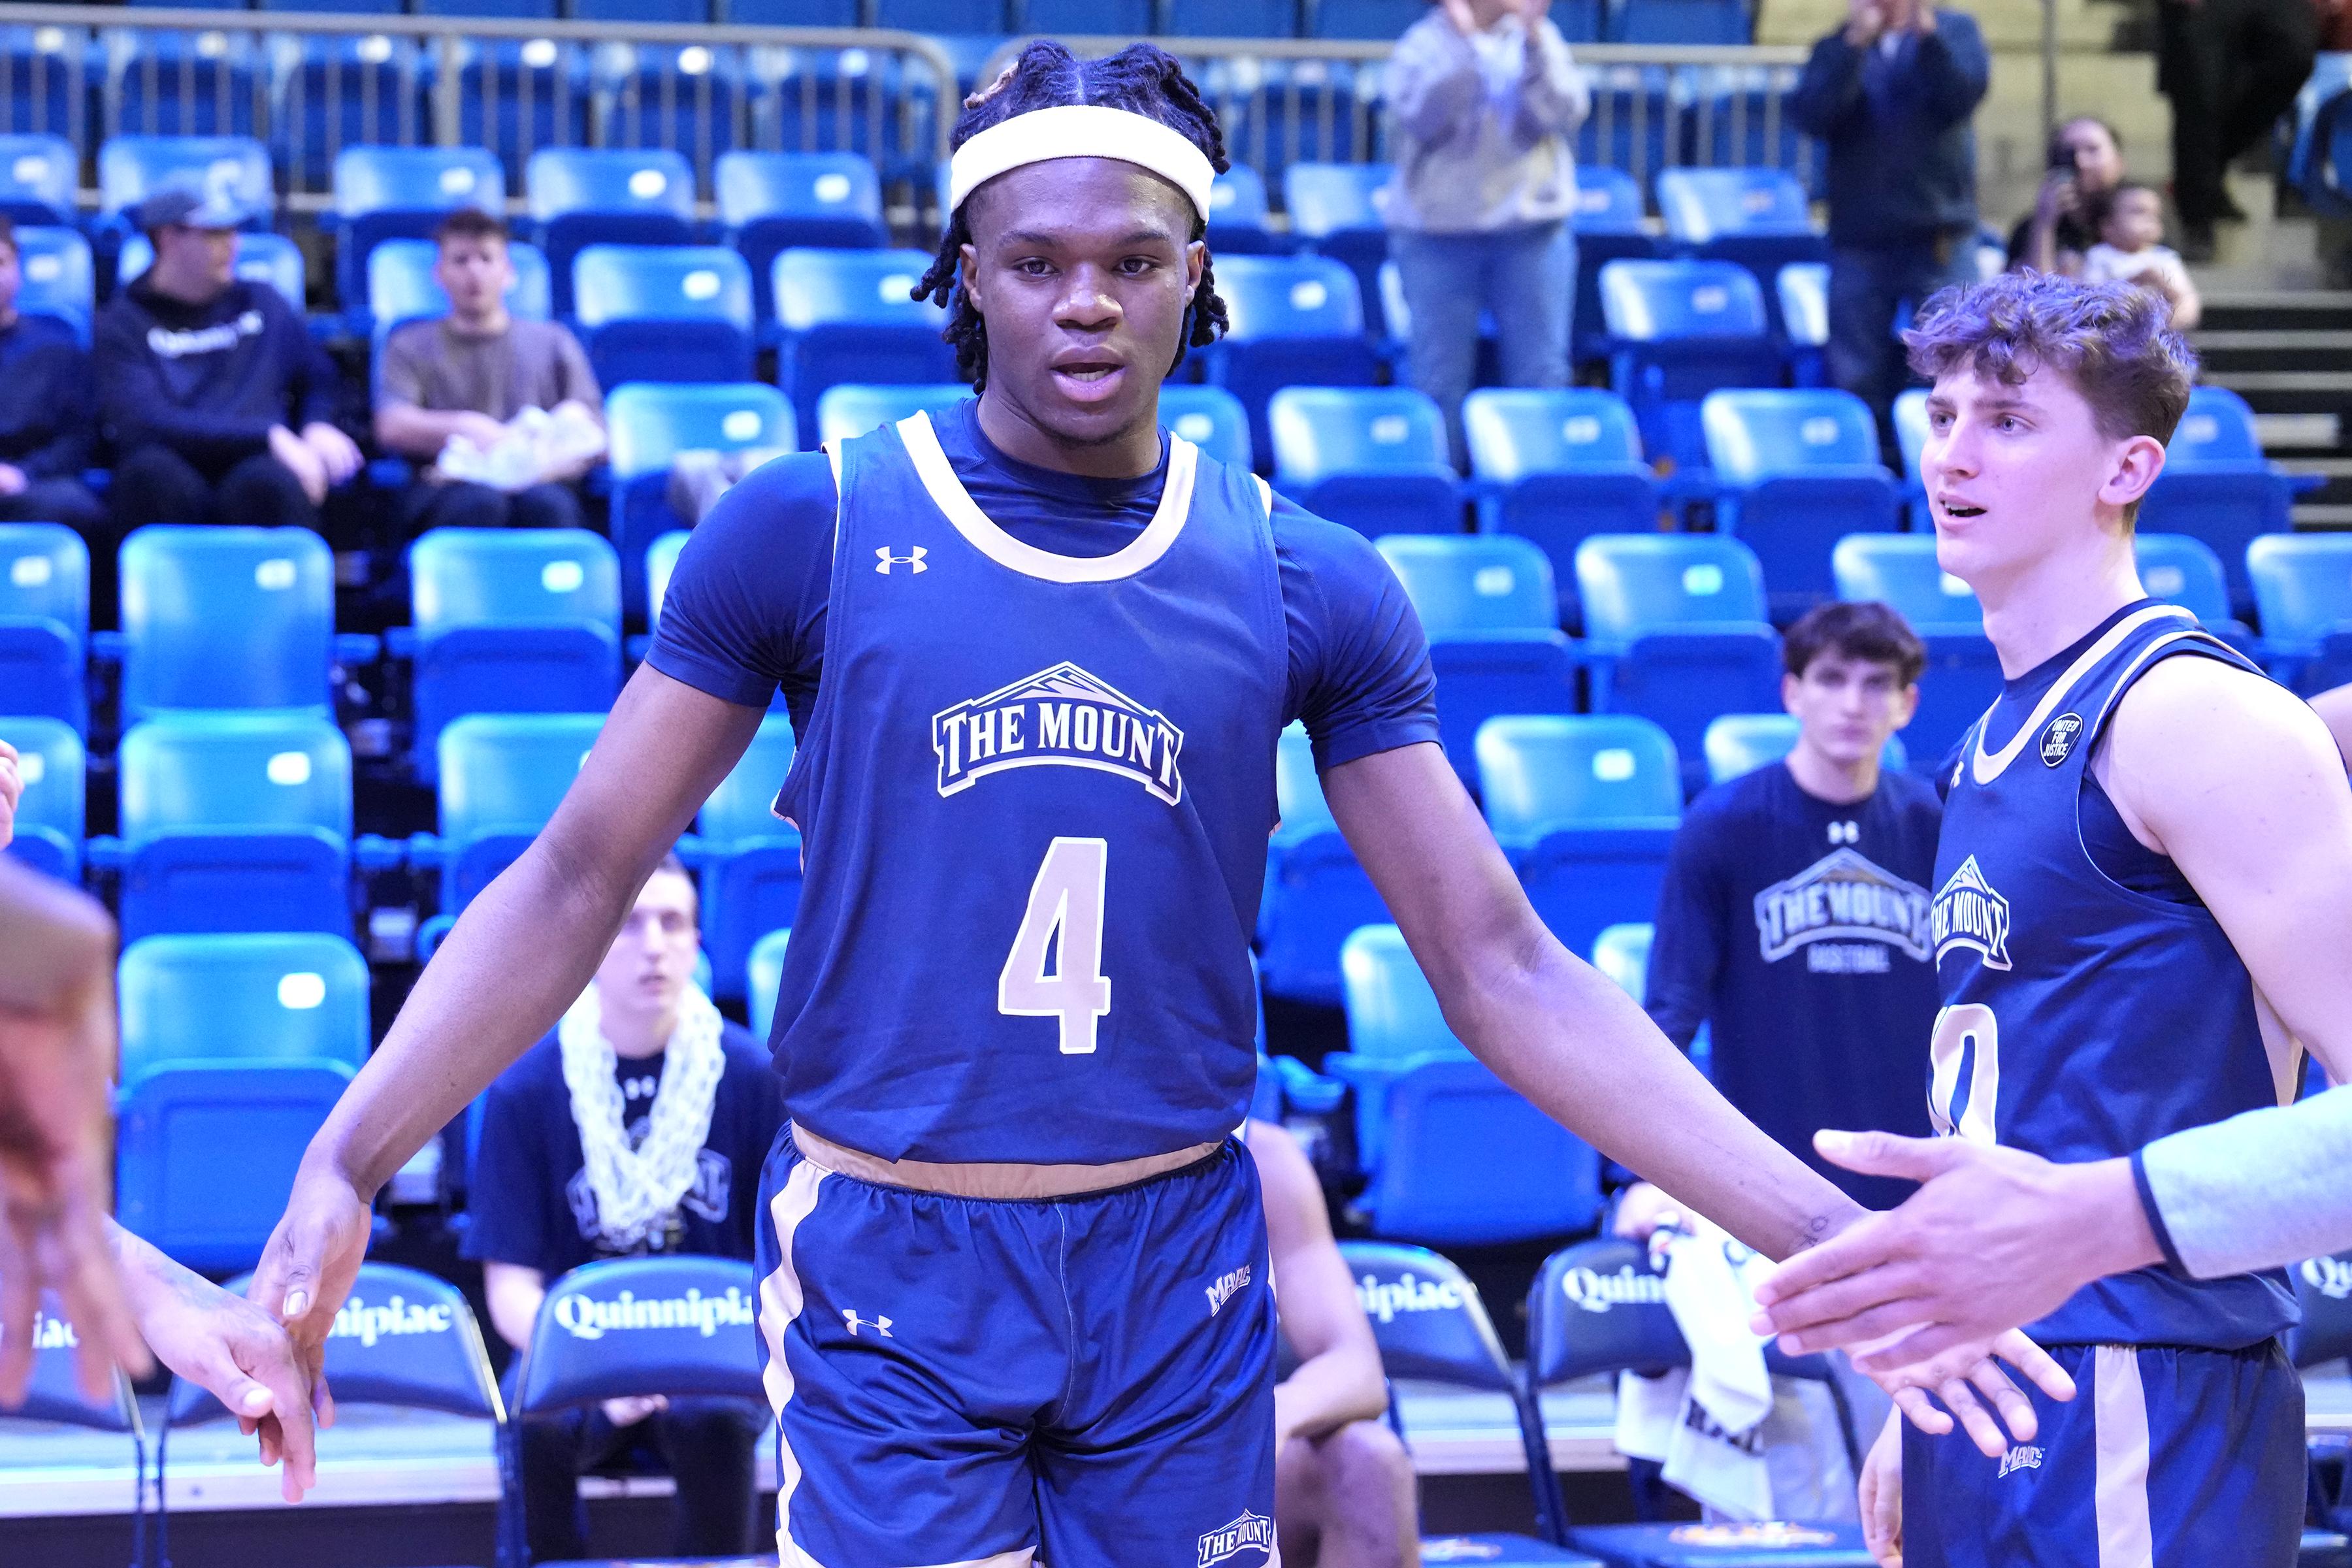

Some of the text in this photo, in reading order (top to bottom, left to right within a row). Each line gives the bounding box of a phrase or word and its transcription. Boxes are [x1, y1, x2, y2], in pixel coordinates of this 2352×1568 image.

[943, 702, 1175, 789] THE MOUNT
[2044, 743, 2068, 757] JUSTICE
[2051, 731, 2067, 743] FOR
[2052, 719, 2080, 732] UNITED
[1766, 881, 1929, 946] THE MOUNT
[1952, 890, 2004, 957] MOUNT
[998, 836, 1111, 1054] 4
[555, 1286, 754, 1339] Quinnipia
[1205, 1264, 1250, 1318] MAAC
[1202, 1530, 1237, 1561] THE
